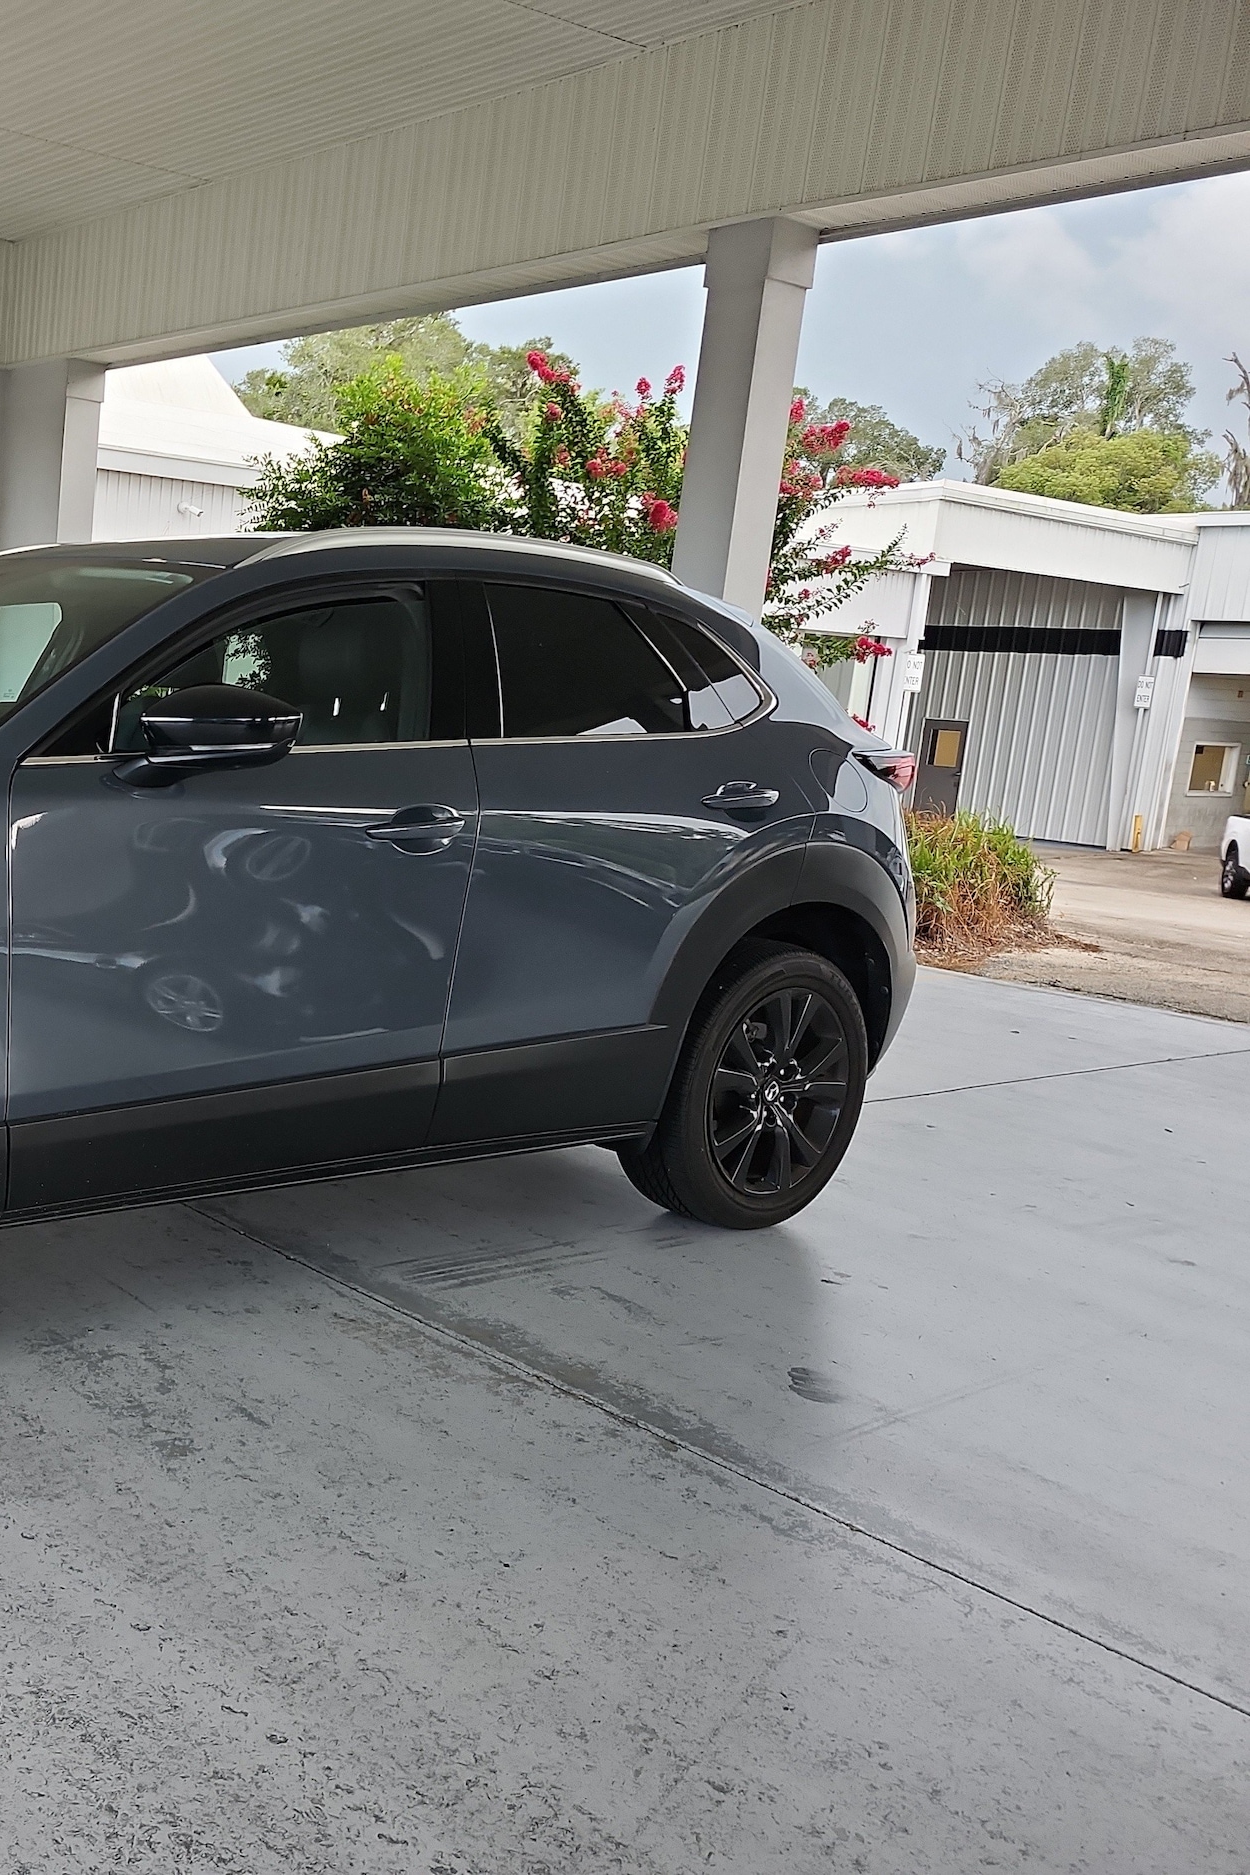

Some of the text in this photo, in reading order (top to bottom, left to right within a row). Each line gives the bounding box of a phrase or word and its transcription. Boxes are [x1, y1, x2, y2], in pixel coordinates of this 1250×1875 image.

[913, 660, 923, 670] NOT
[1137, 680, 1154, 689] DO NOT
[1136, 694, 1150, 703] ENTER
